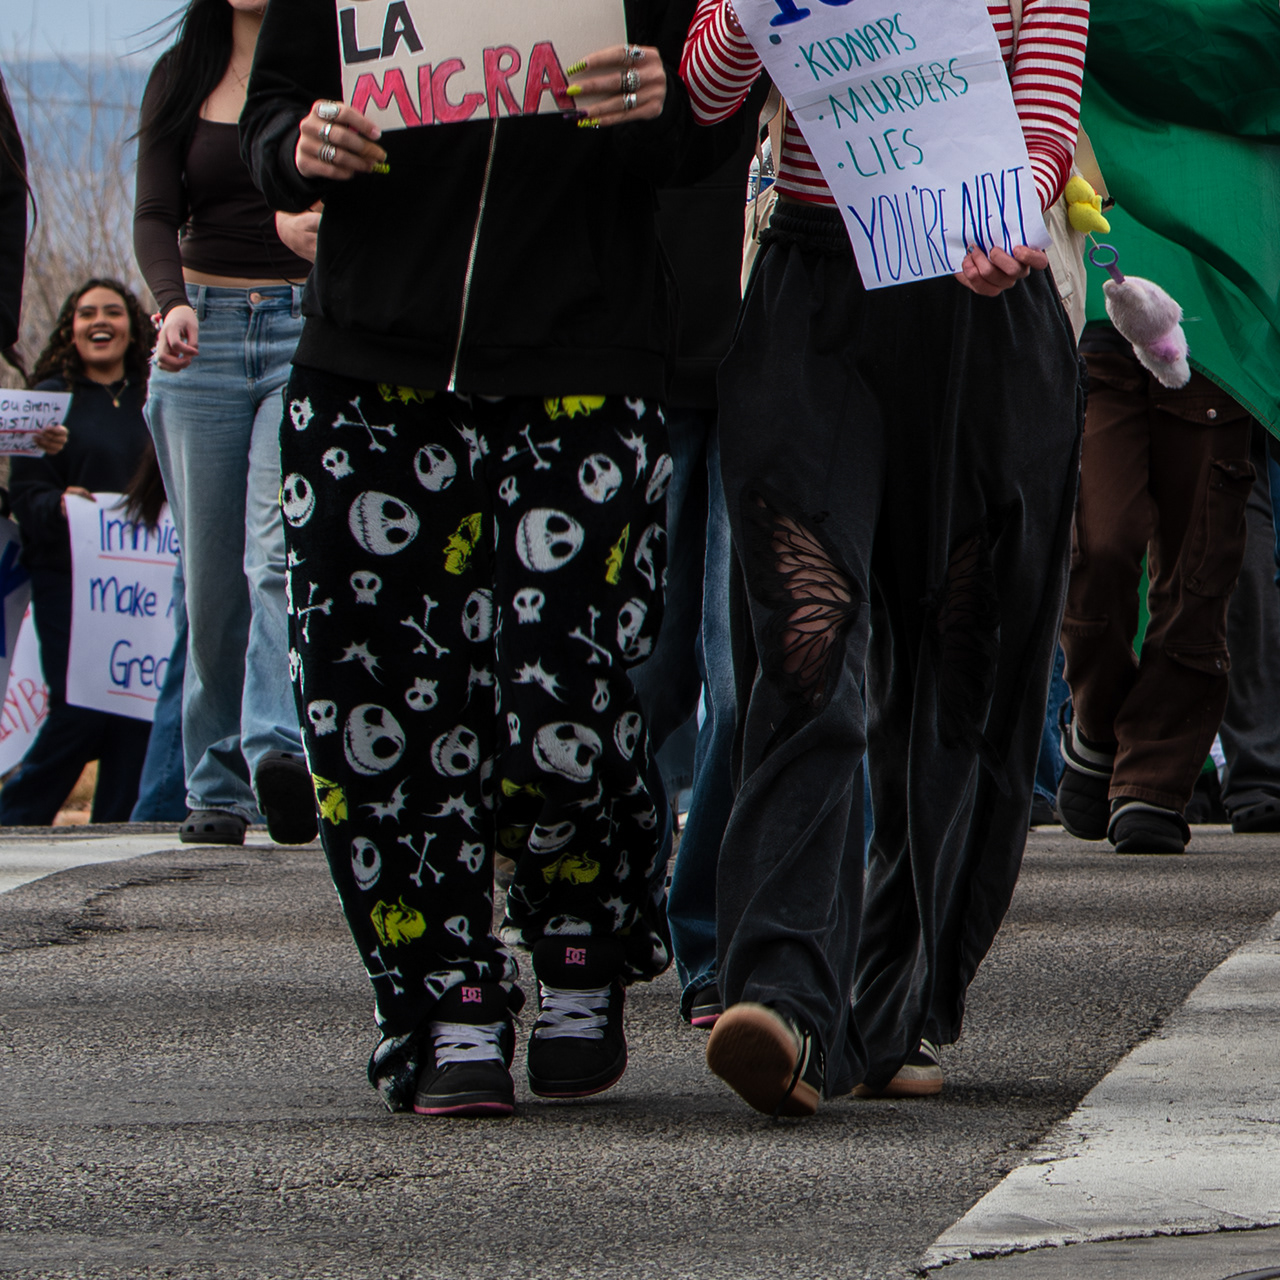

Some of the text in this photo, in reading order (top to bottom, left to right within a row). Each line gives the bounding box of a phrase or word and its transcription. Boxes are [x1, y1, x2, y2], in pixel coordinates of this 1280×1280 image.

[339, 0, 425, 66] LA
[799, 12, 917, 82] KIDNAPS
[351, 40, 577, 128] MIGRA
[828, 57, 970, 130] MURDERS
[845, 126, 925, 178] LIES
[846, 165, 1028, 284] YOU'RE NEXT
